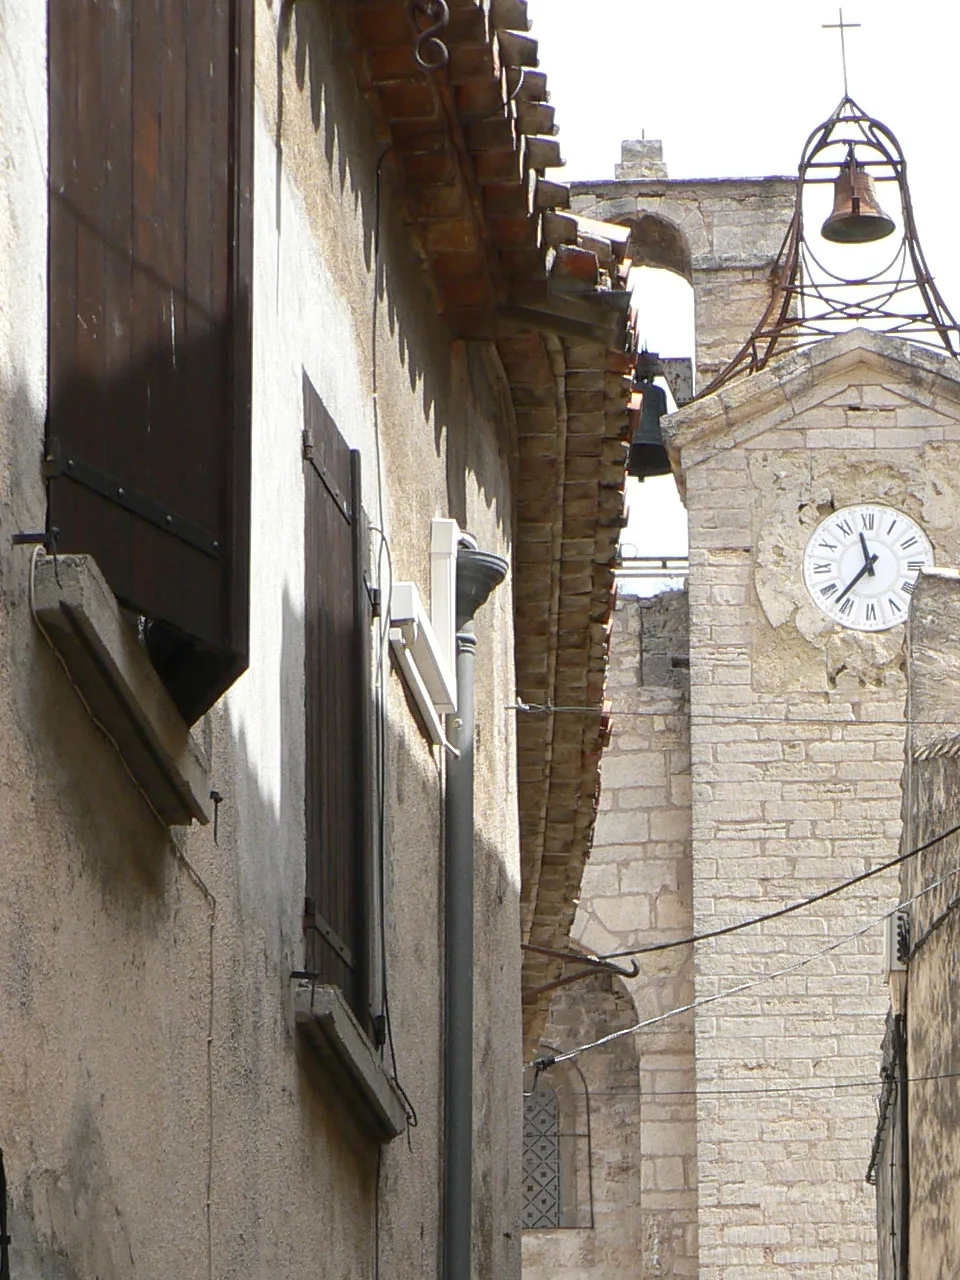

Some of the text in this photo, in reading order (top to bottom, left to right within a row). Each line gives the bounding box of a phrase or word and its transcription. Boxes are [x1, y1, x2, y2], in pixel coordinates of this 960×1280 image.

[836, 519, 854, 538] XI
[861, 513, 874, 531] XII
[887, 520, 897, 535] I
[818, 538, 838, 553] X
[900, 536, 918, 550] II
[866, 603, 876, 621] VI
[889, 598, 902, 616] V
